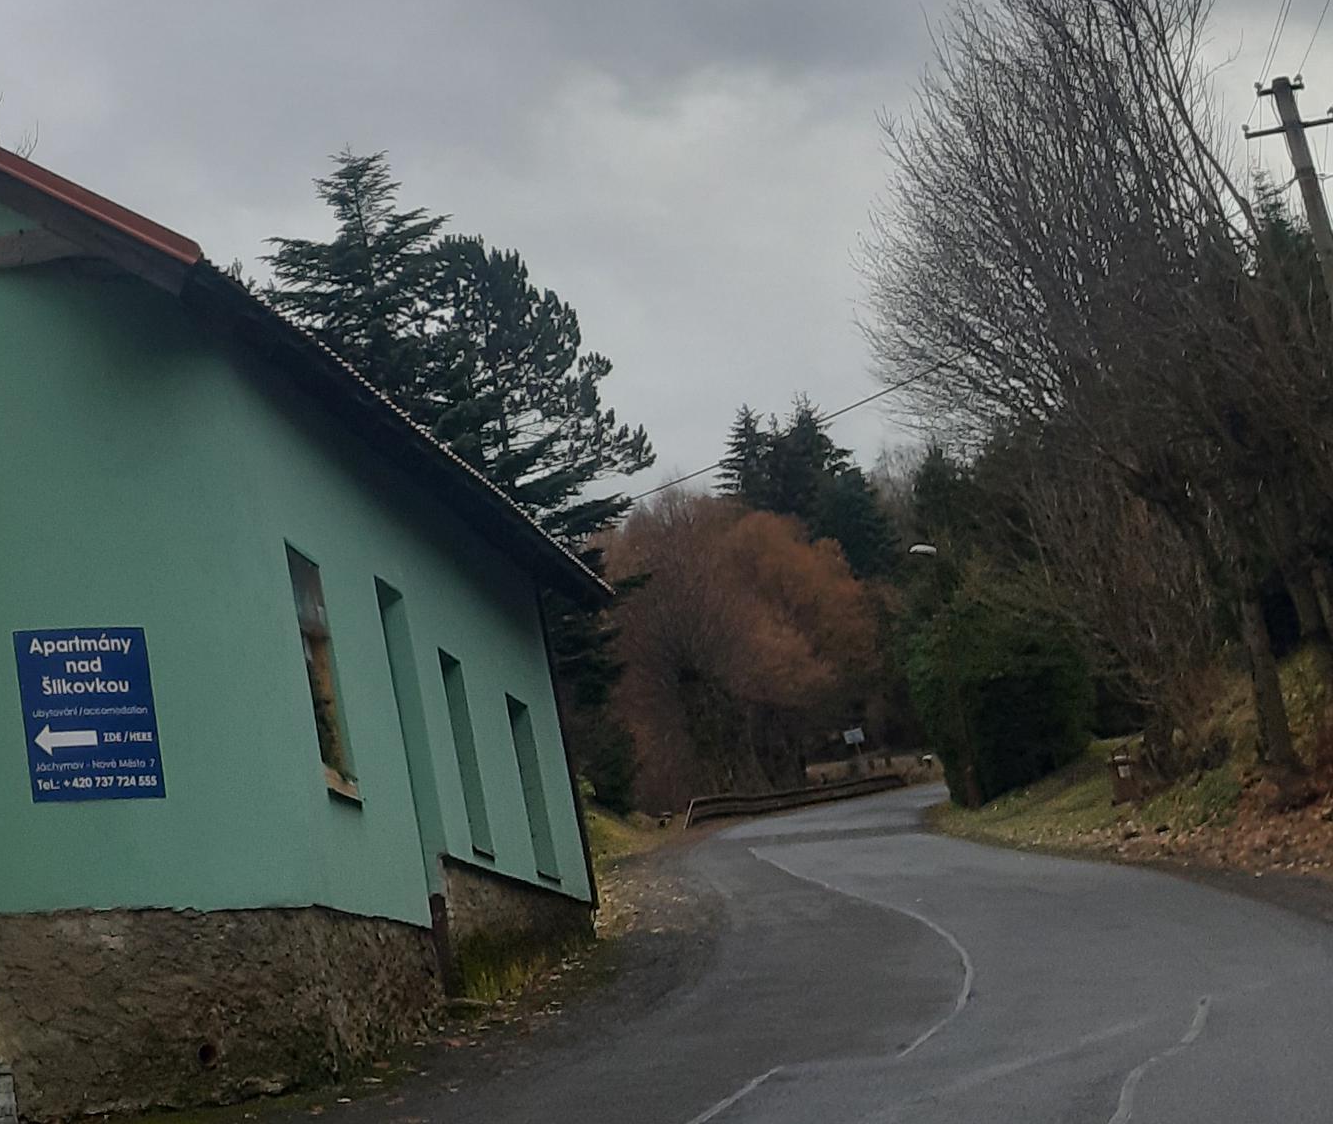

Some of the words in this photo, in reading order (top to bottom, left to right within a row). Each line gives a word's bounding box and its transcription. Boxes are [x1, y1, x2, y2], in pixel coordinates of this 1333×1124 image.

[29, 633, 131, 657] Apartmány
[65, 656, 102, 674] nad
[41, 676, 129, 695] Šlikovkou
[149, 758, 156, 768] 7
[95, 775, 114, 788] 737
[116, 775, 137, 787] 724
